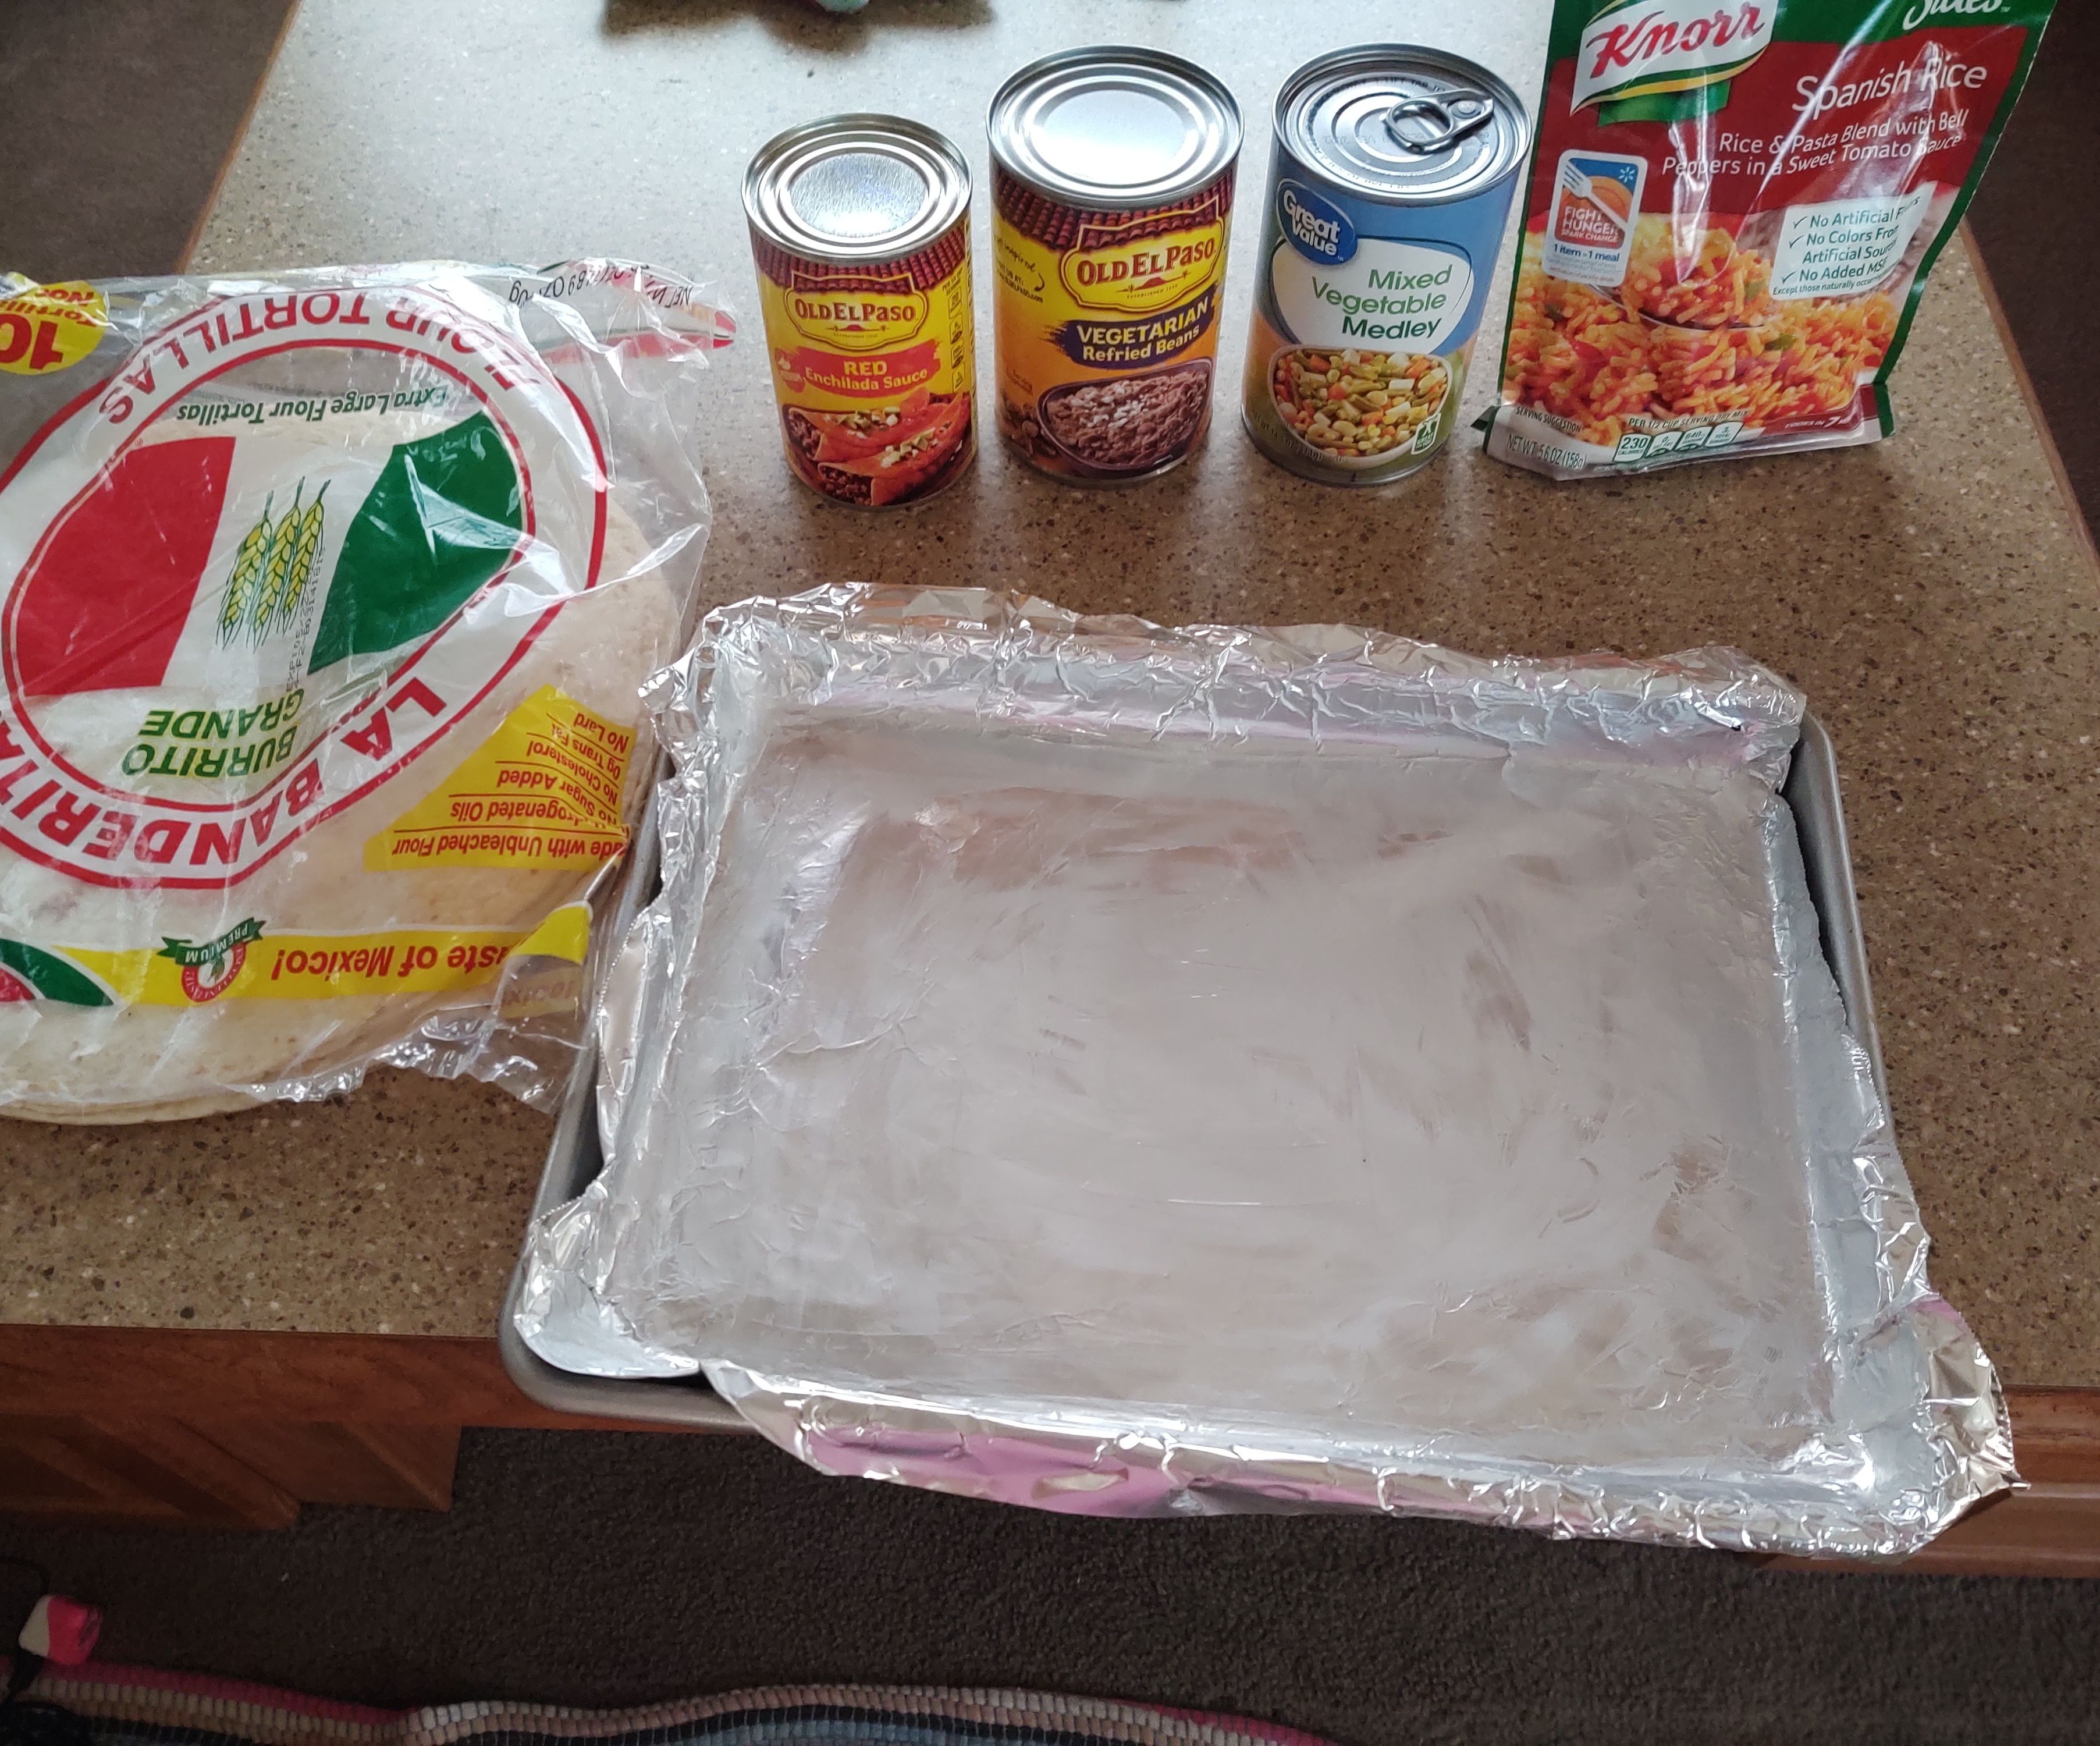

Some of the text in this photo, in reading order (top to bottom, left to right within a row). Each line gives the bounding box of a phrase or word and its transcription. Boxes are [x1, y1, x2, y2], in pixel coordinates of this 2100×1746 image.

[1586, 3, 1765, 80] Knorr
[1792, 56, 1988, 120] Spanish Rice
[1718, 108, 1970, 154] Rice & Pasta Blend with Bell
[1662, 134, 1962, 180] Peppers in a Sweet Tomato Sauce
[1284, 190, 1341, 243] Great
[1810, 208, 1892, 229] No Artificial
[1292, 214, 1337, 256] Value
[1585, 233, 1618, 243] CHANGE
[1806, 233, 1825, 246] No
[1829, 230, 1872, 244] Colors
[1559, 244, 1582, 257] item
[1595, 253, 1621, 262] meal
[1802, 247, 1862, 264] Artificial
[1368, 264, 1453, 290] Mixed
[1772, 278, 1855, 296] Except those naturally
[1799, 269, 1818, 282] No
[1820, 263, 1865, 281] Added
[1312, 276, 1447, 315] Vegetable
[1077, 296, 1209, 345] VEGETARIAN
[1342, 315, 1443, 339] Medley
[1083, 324, 1200, 362] Refried Beans
[99, 293, 370, 424] TORTILLAS
[843, 360, 888, 376] RED
[805, 367, 879, 390] Enchilada
[884, 368, 928, 389] Sauce
[176, 385, 448, 426] Extra Large Flour Tortillas
[1516, 406, 1582, 433] SERVING SUGGESTION
[1629, 417, 1645, 428] PER
[1648, 419, 1660, 428] 1/2
[1662, 420, 1679, 428] CUP
[1680, 414, 1714, 426] SERVING
[1824, 416, 1842, 428] 7
[1506, 434, 1523, 452] NET
[1523, 437, 1538, 455] WT
[1550, 448, 1563, 465] OZ
[1621, 438, 1648, 450] 230
[138, 688, 304, 739] GRANDE
[340, 677, 447, 761] LA
[552, 723, 570, 747] Fat
[573, 712, 630, 754] No Lard
[122, 725, 298, 778] BURRITO
[572, 739, 604, 769] Trans
[497, 769, 557, 790] Added
[526, 740, 618, 807] No Cholesterol
[451, 802, 484, 822] Oils
[559, 781, 596, 817] Sugar
[392, 837, 435, 857] Flour
[440, 835, 542, 857] Unbleached
[548, 837, 585, 858] with
[185, 923, 248, 963] PREMIUM
[271, 945, 395, 981] Mexico!
[397, 945, 438, 978] of
